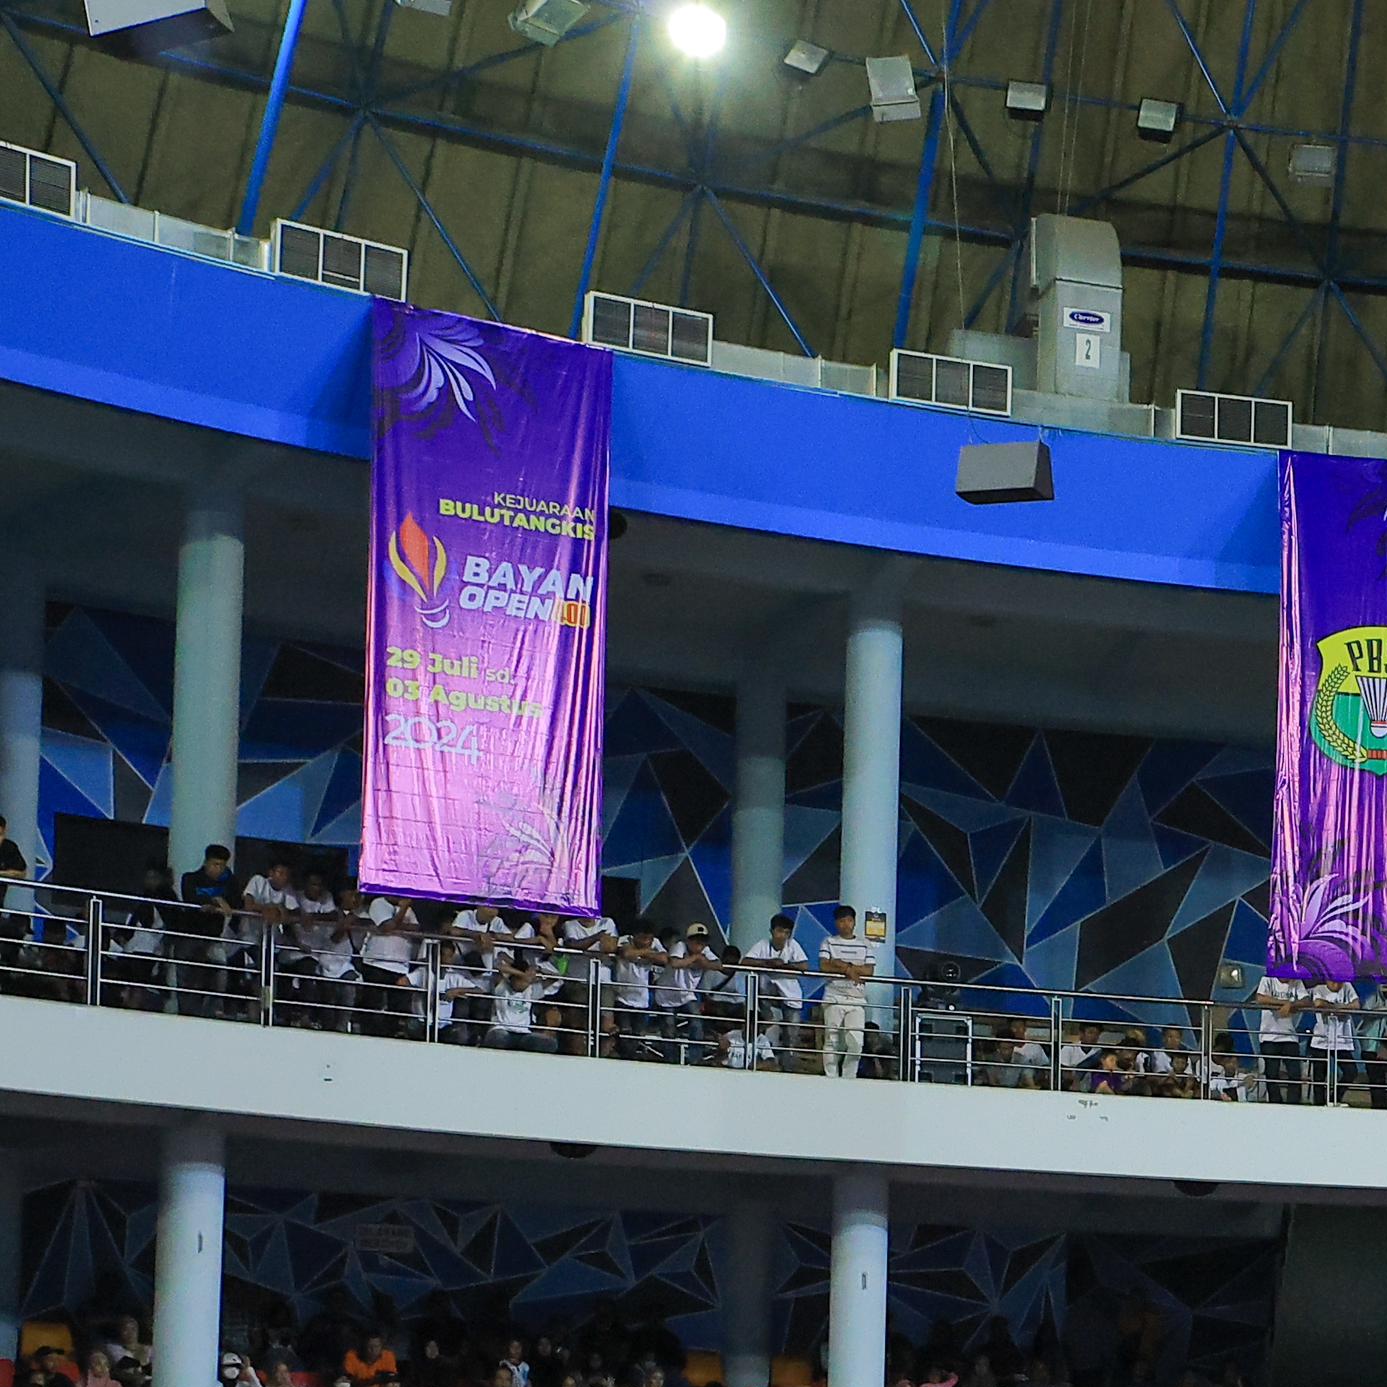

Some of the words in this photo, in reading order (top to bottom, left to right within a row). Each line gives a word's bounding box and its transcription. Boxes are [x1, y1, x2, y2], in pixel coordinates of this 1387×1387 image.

[1085, 339, 1091, 360] 2
[439, 499, 595, 541] BULUTANGKIS
[494, 491, 595, 522] KEJUARAAN
[462, 555, 593, 602] BAYAN
[386, 646, 420, 670] 29
[427, 650, 478, 680] Juli
[386, 677, 420, 701] 03
[425, 684, 543, 719] Agustus
[385, 714, 480, 765] 2024
